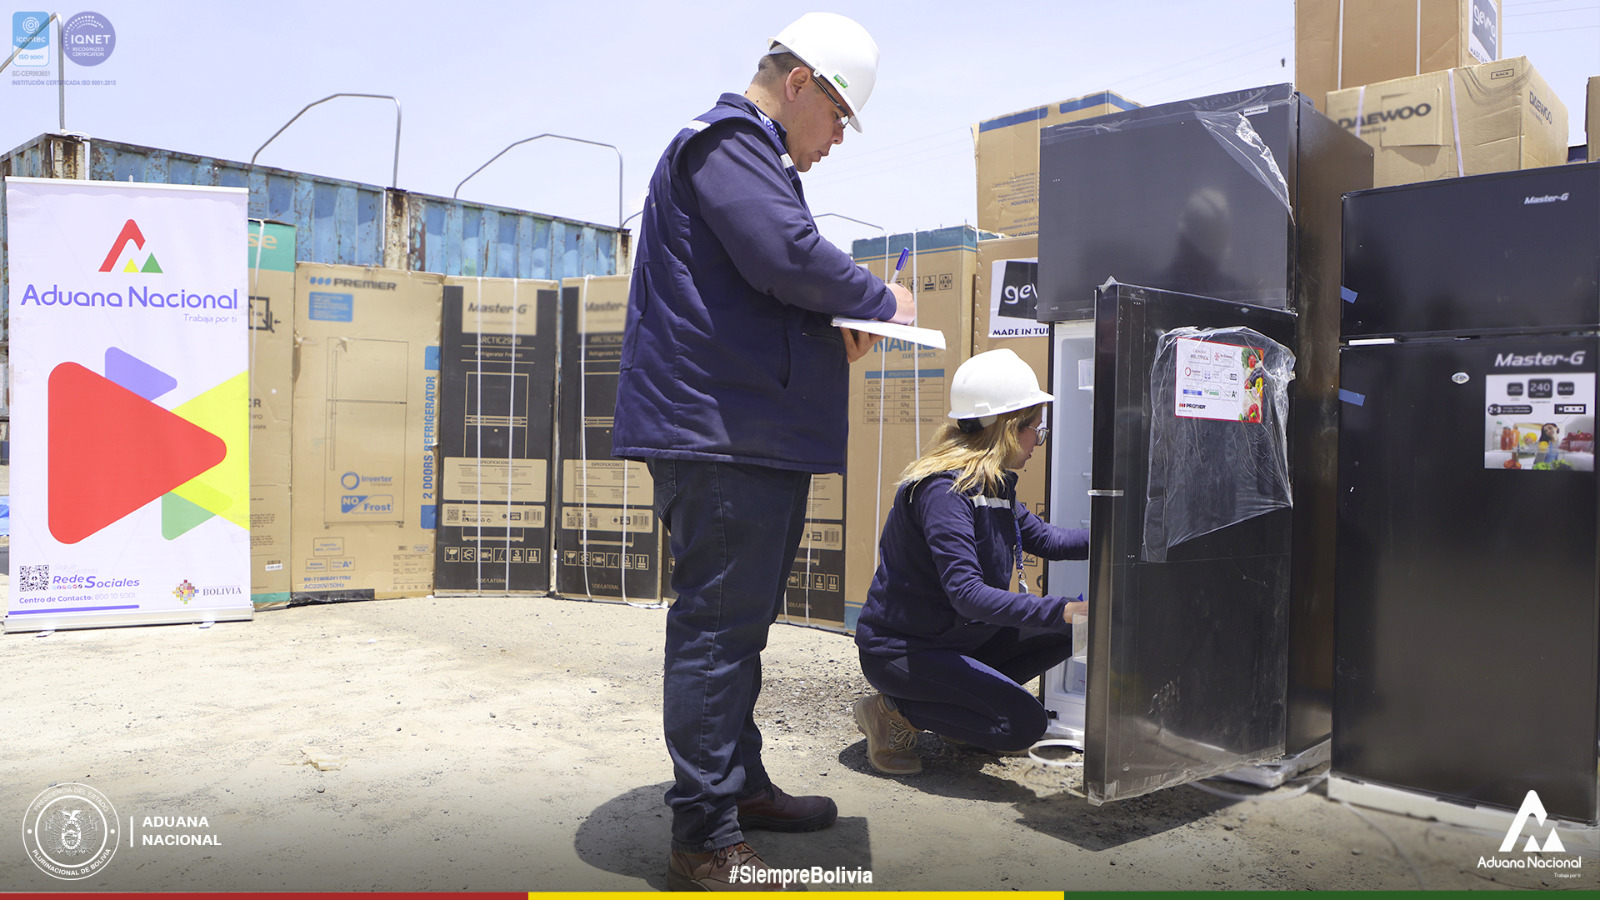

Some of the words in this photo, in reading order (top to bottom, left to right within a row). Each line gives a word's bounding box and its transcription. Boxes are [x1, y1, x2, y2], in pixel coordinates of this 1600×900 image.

[1529, 90, 1552, 125] DAEWOO
[1338, 102, 1432, 130] DAEWOO
[1523, 192, 1570, 205] Master-G
[333, 277, 398, 291] PREMIER
[20, 283, 123, 307] Aduana
[128, 286, 238, 309] Nacional
[467, 302, 528, 315] Master-G
[183, 313, 214, 324] Trabaja
[215, 316, 230, 324] por
[992, 327, 1020, 336] MADE
[1021, 327, 1032, 335] IN
[1494, 350, 1587, 367] Master-G
[1530, 382, 1551, 392] 240
[423, 376, 436, 452] REFRIGERATOR
[422, 454, 434, 490] DOORS
[361, 475, 393, 483] Inverter
[342, 497, 360, 506] NO
[422, 492, 433, 500] 2
[363, 502, 391, 512] Frost
[203, 587, 242, 596] BOLIVIA
[19, 596, 45, 604] Centro
[57, 594, 94, 602] Contacto:
